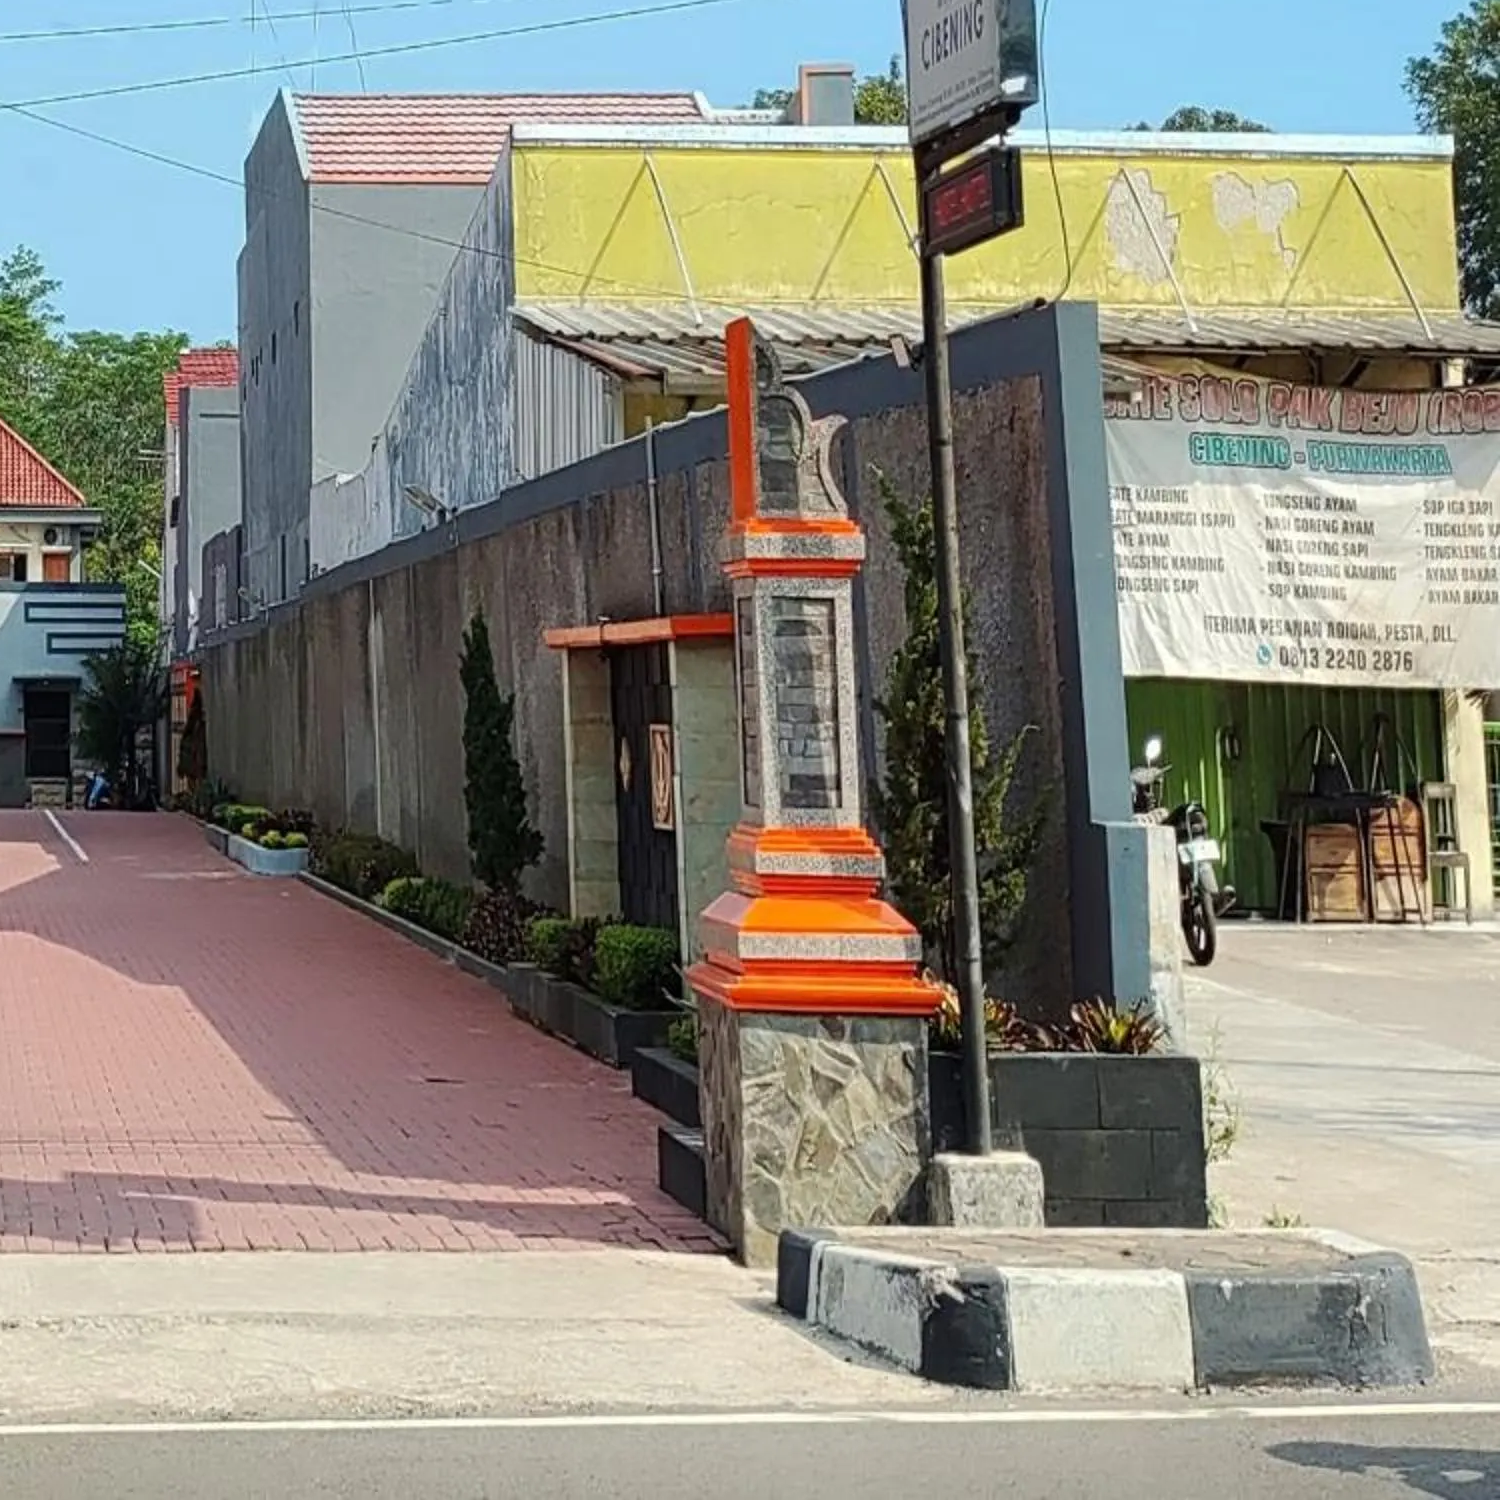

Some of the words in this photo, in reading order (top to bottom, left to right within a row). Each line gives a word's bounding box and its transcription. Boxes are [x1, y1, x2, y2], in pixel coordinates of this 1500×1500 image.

[1177, 373, 1259, 426] SOLO
[1267, 381, 1333, 431] PAK
[1339, 388, 1420, 436] BEJO
[1190, 432, 1291, 469] CIBENING
[1307, 440, 1451, 473] PURWAKARTA
[1136, 488, 1189, 504] KAMBING
[1325, 496, 1358, 513] AYAM
[1342, 520, 1375, 537] AYAM
[1342, 542, 1369, 558] SAPI
[1279, 645, 1320, 669] 0813
[1325, 647, 1367, 671] 2240
[1372, 649, 1414, 672] 2876
